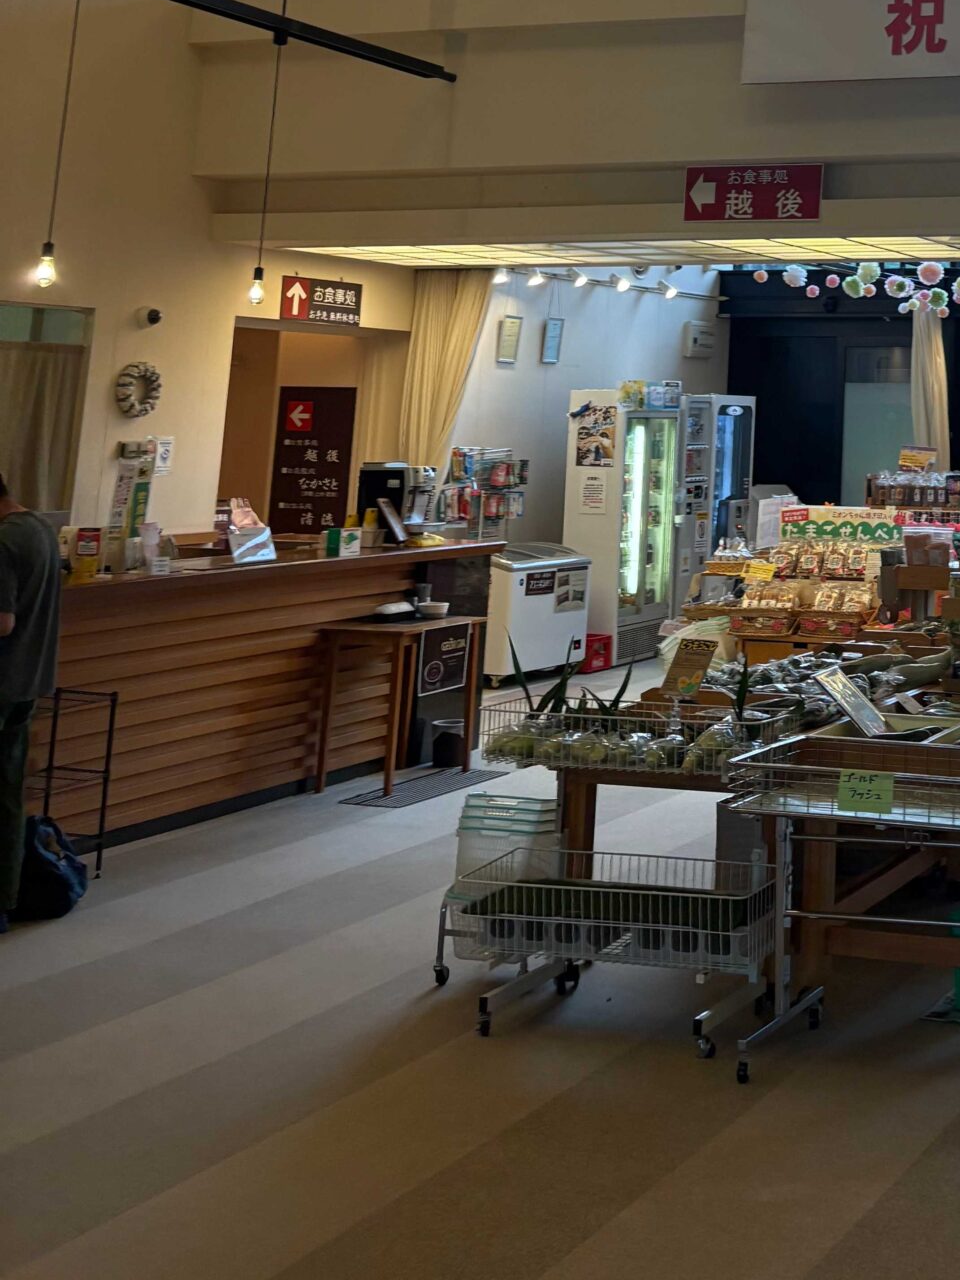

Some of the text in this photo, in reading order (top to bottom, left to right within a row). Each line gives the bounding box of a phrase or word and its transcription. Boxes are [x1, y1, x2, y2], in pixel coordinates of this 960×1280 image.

[727, 169, 789, 185] お食事処
[724, 188, 803, 219] 越後
[312, 285, 356, 306] お食事処
[298, 477, 340, 491] なかさと
[842, 772, 880, 784] ゴールド
[847, 786, 883, 800] ラッシュ
